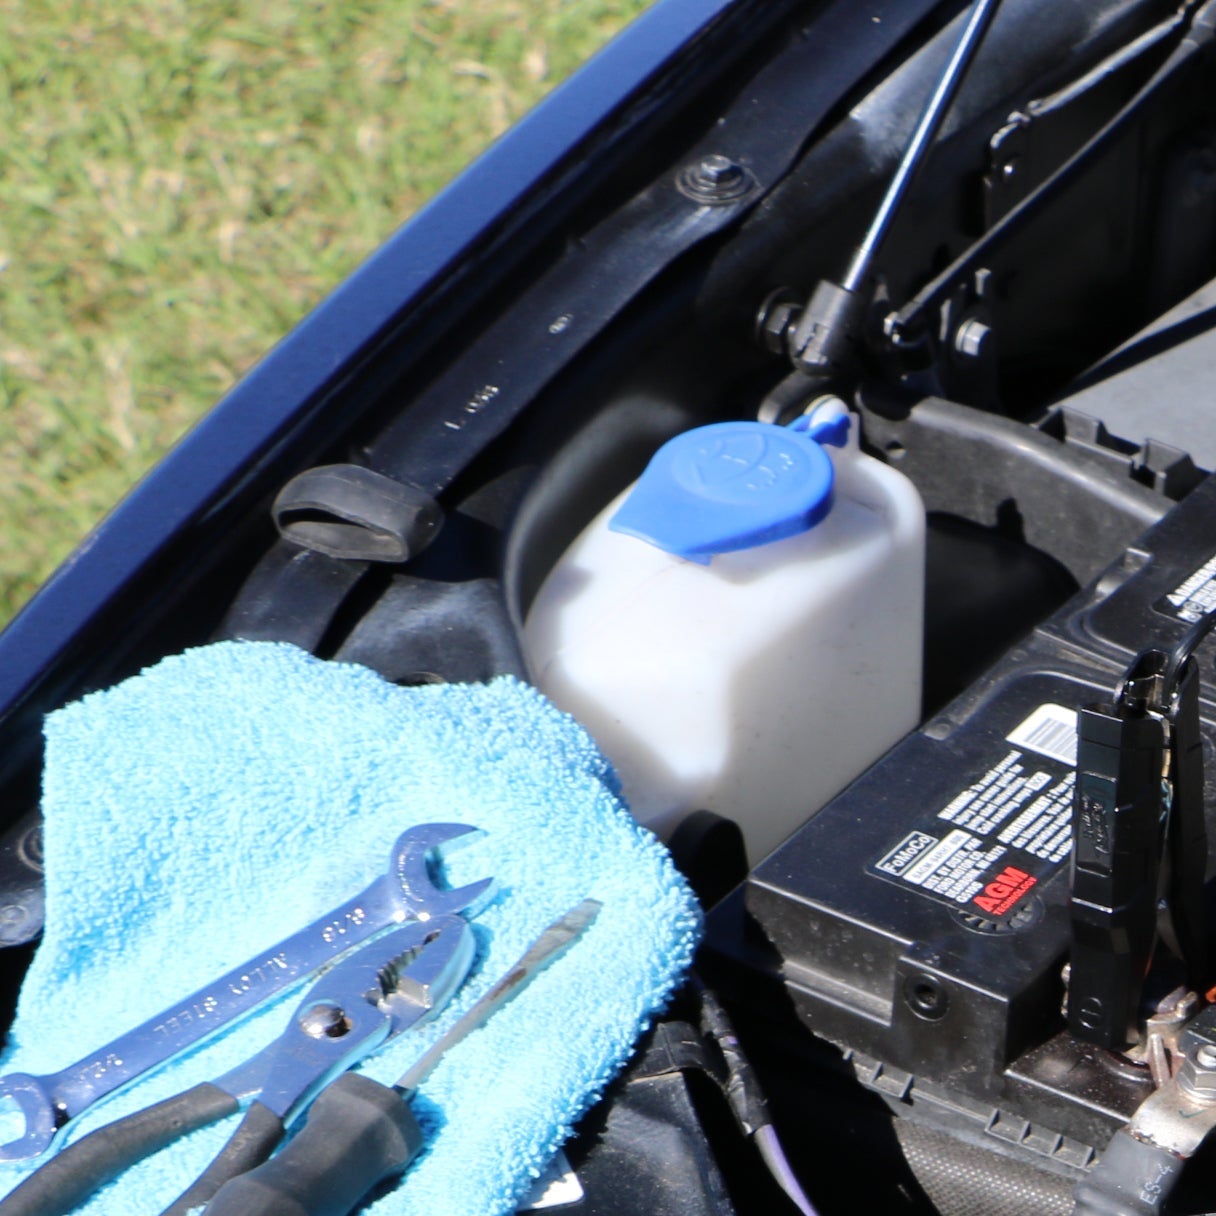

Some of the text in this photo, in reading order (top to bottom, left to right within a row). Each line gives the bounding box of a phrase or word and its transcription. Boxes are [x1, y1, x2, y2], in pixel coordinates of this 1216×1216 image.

[884, 835, 931, 873] FoMoCo
[973, 866, 1030, 913] AGM
[1139, 1162, 1174, 1205] ES-4
